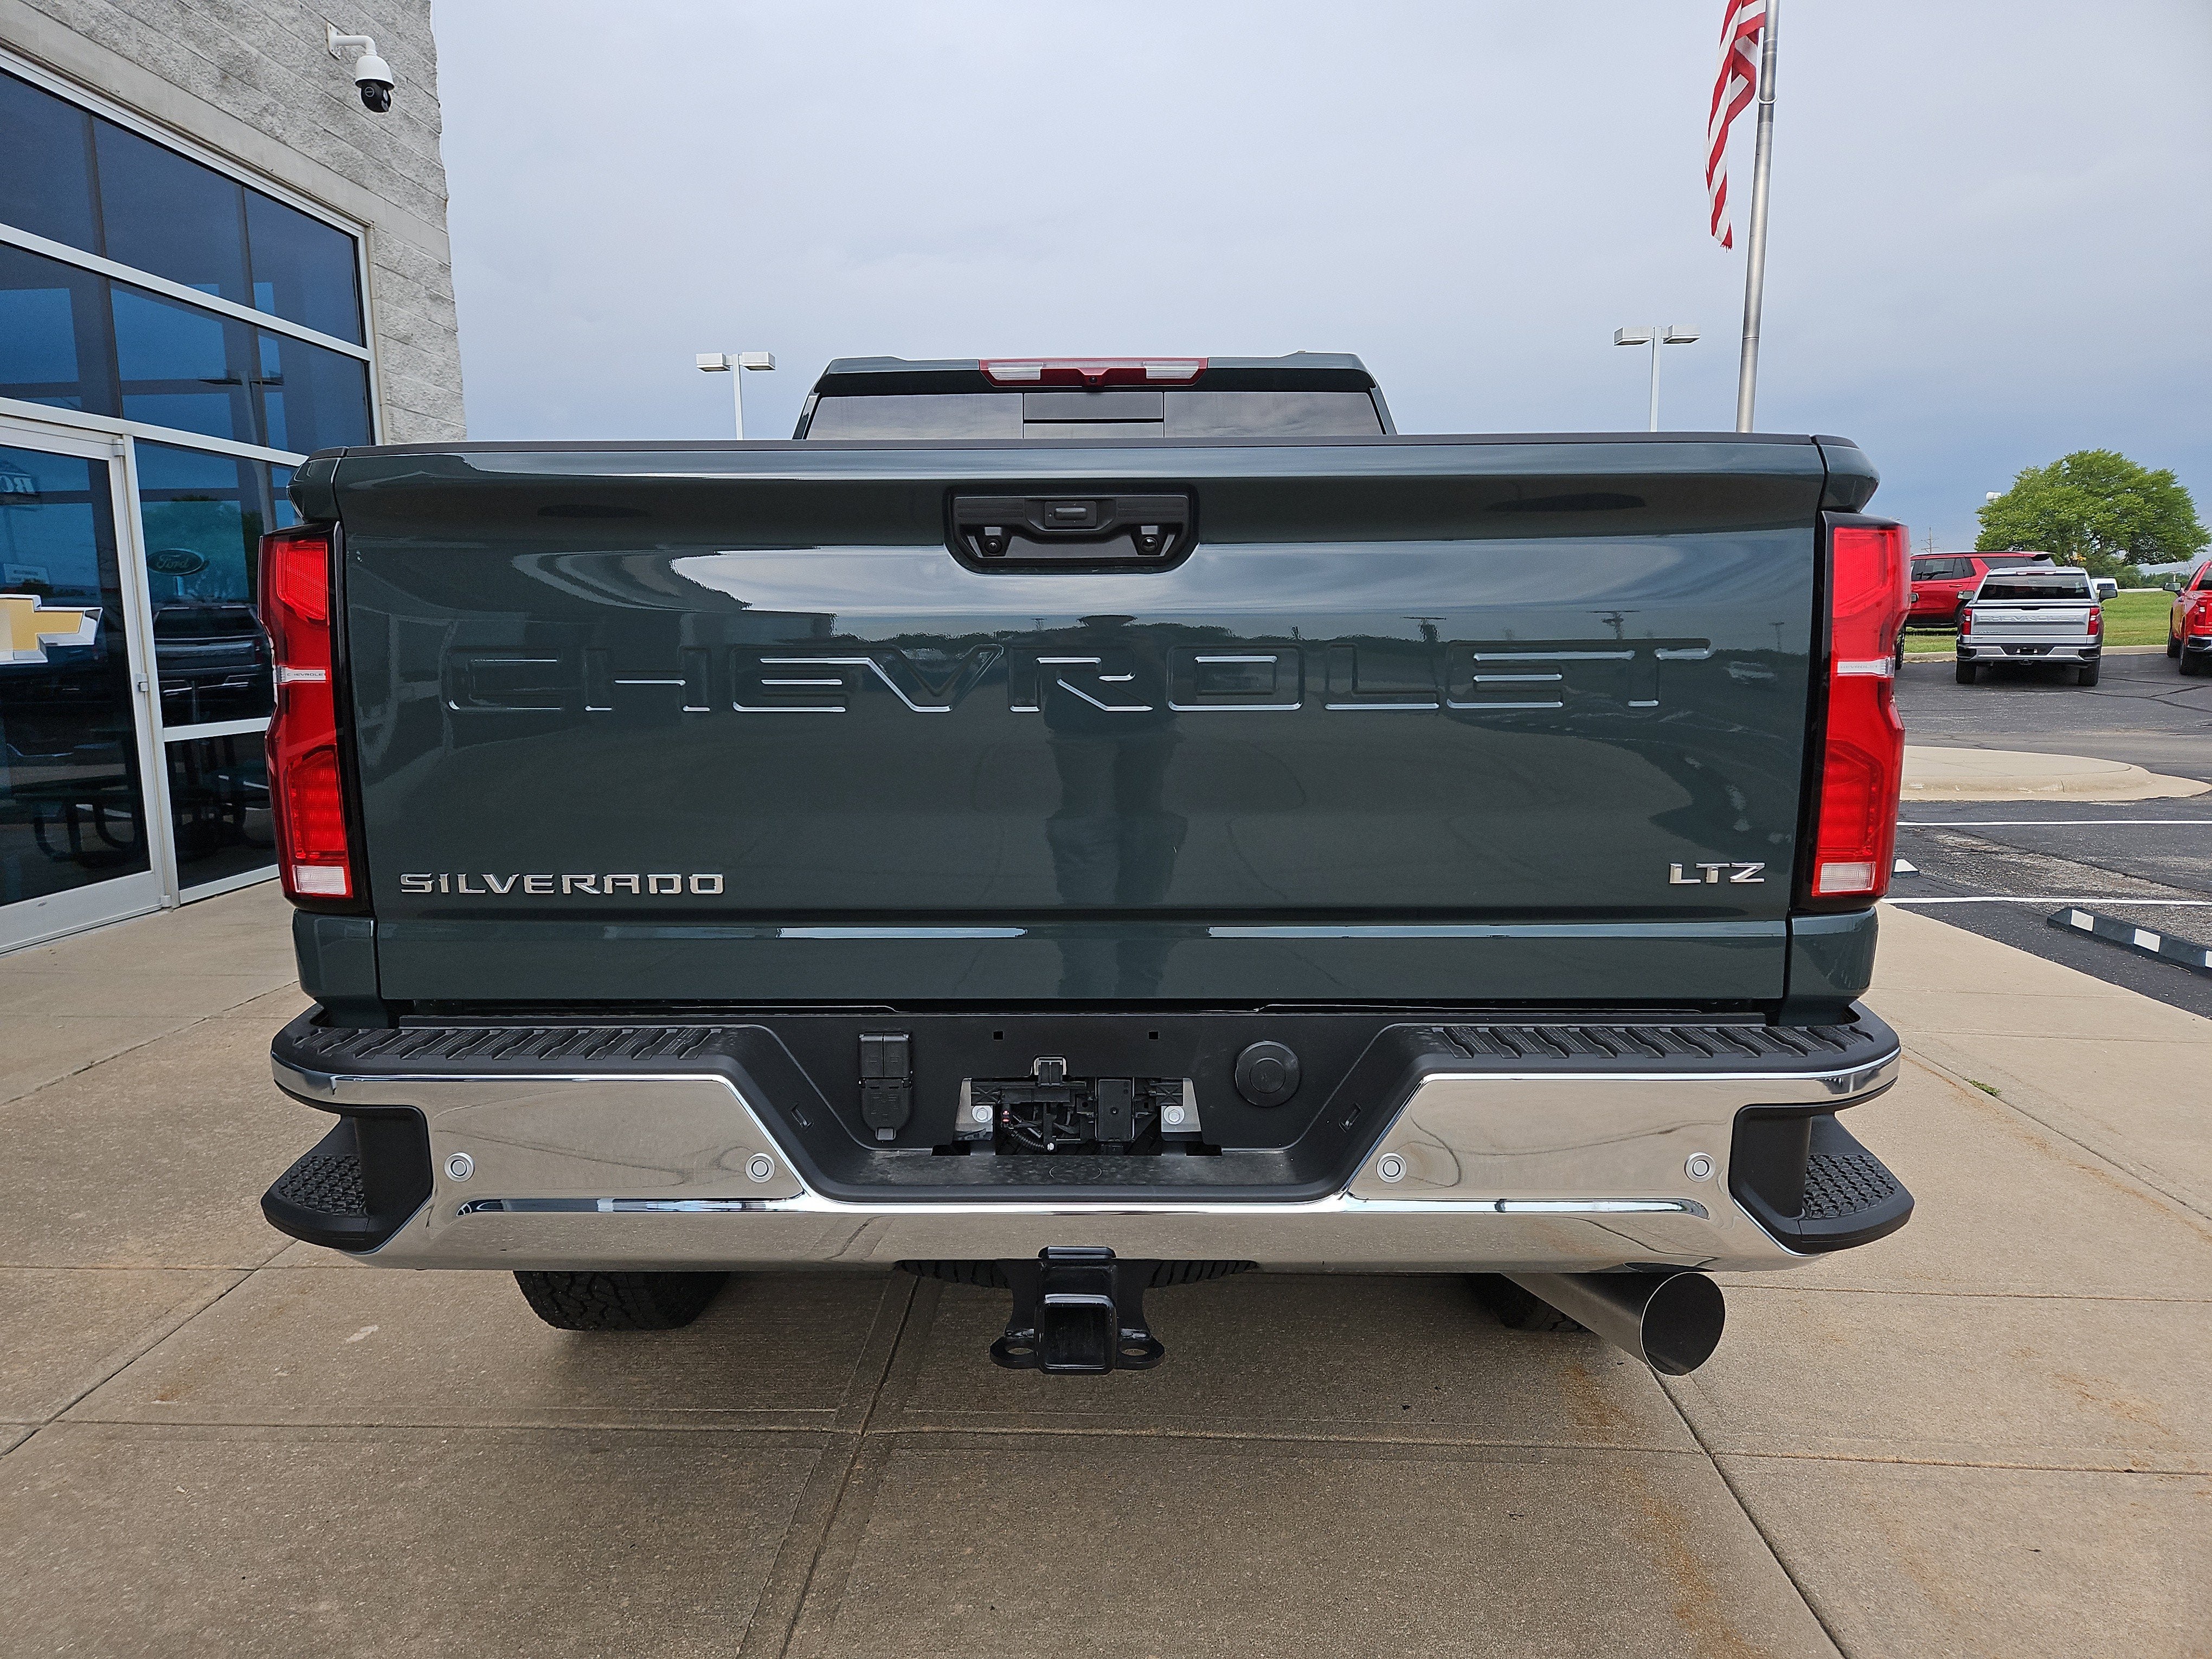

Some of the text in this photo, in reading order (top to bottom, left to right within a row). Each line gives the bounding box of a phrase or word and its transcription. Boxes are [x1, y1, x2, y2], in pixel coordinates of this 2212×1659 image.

[443, 640, 1712, 712] CHEVROLET
[400, 873, 725, 894] SILVERADO
[1669, 863, 1765, 884] LTZ
